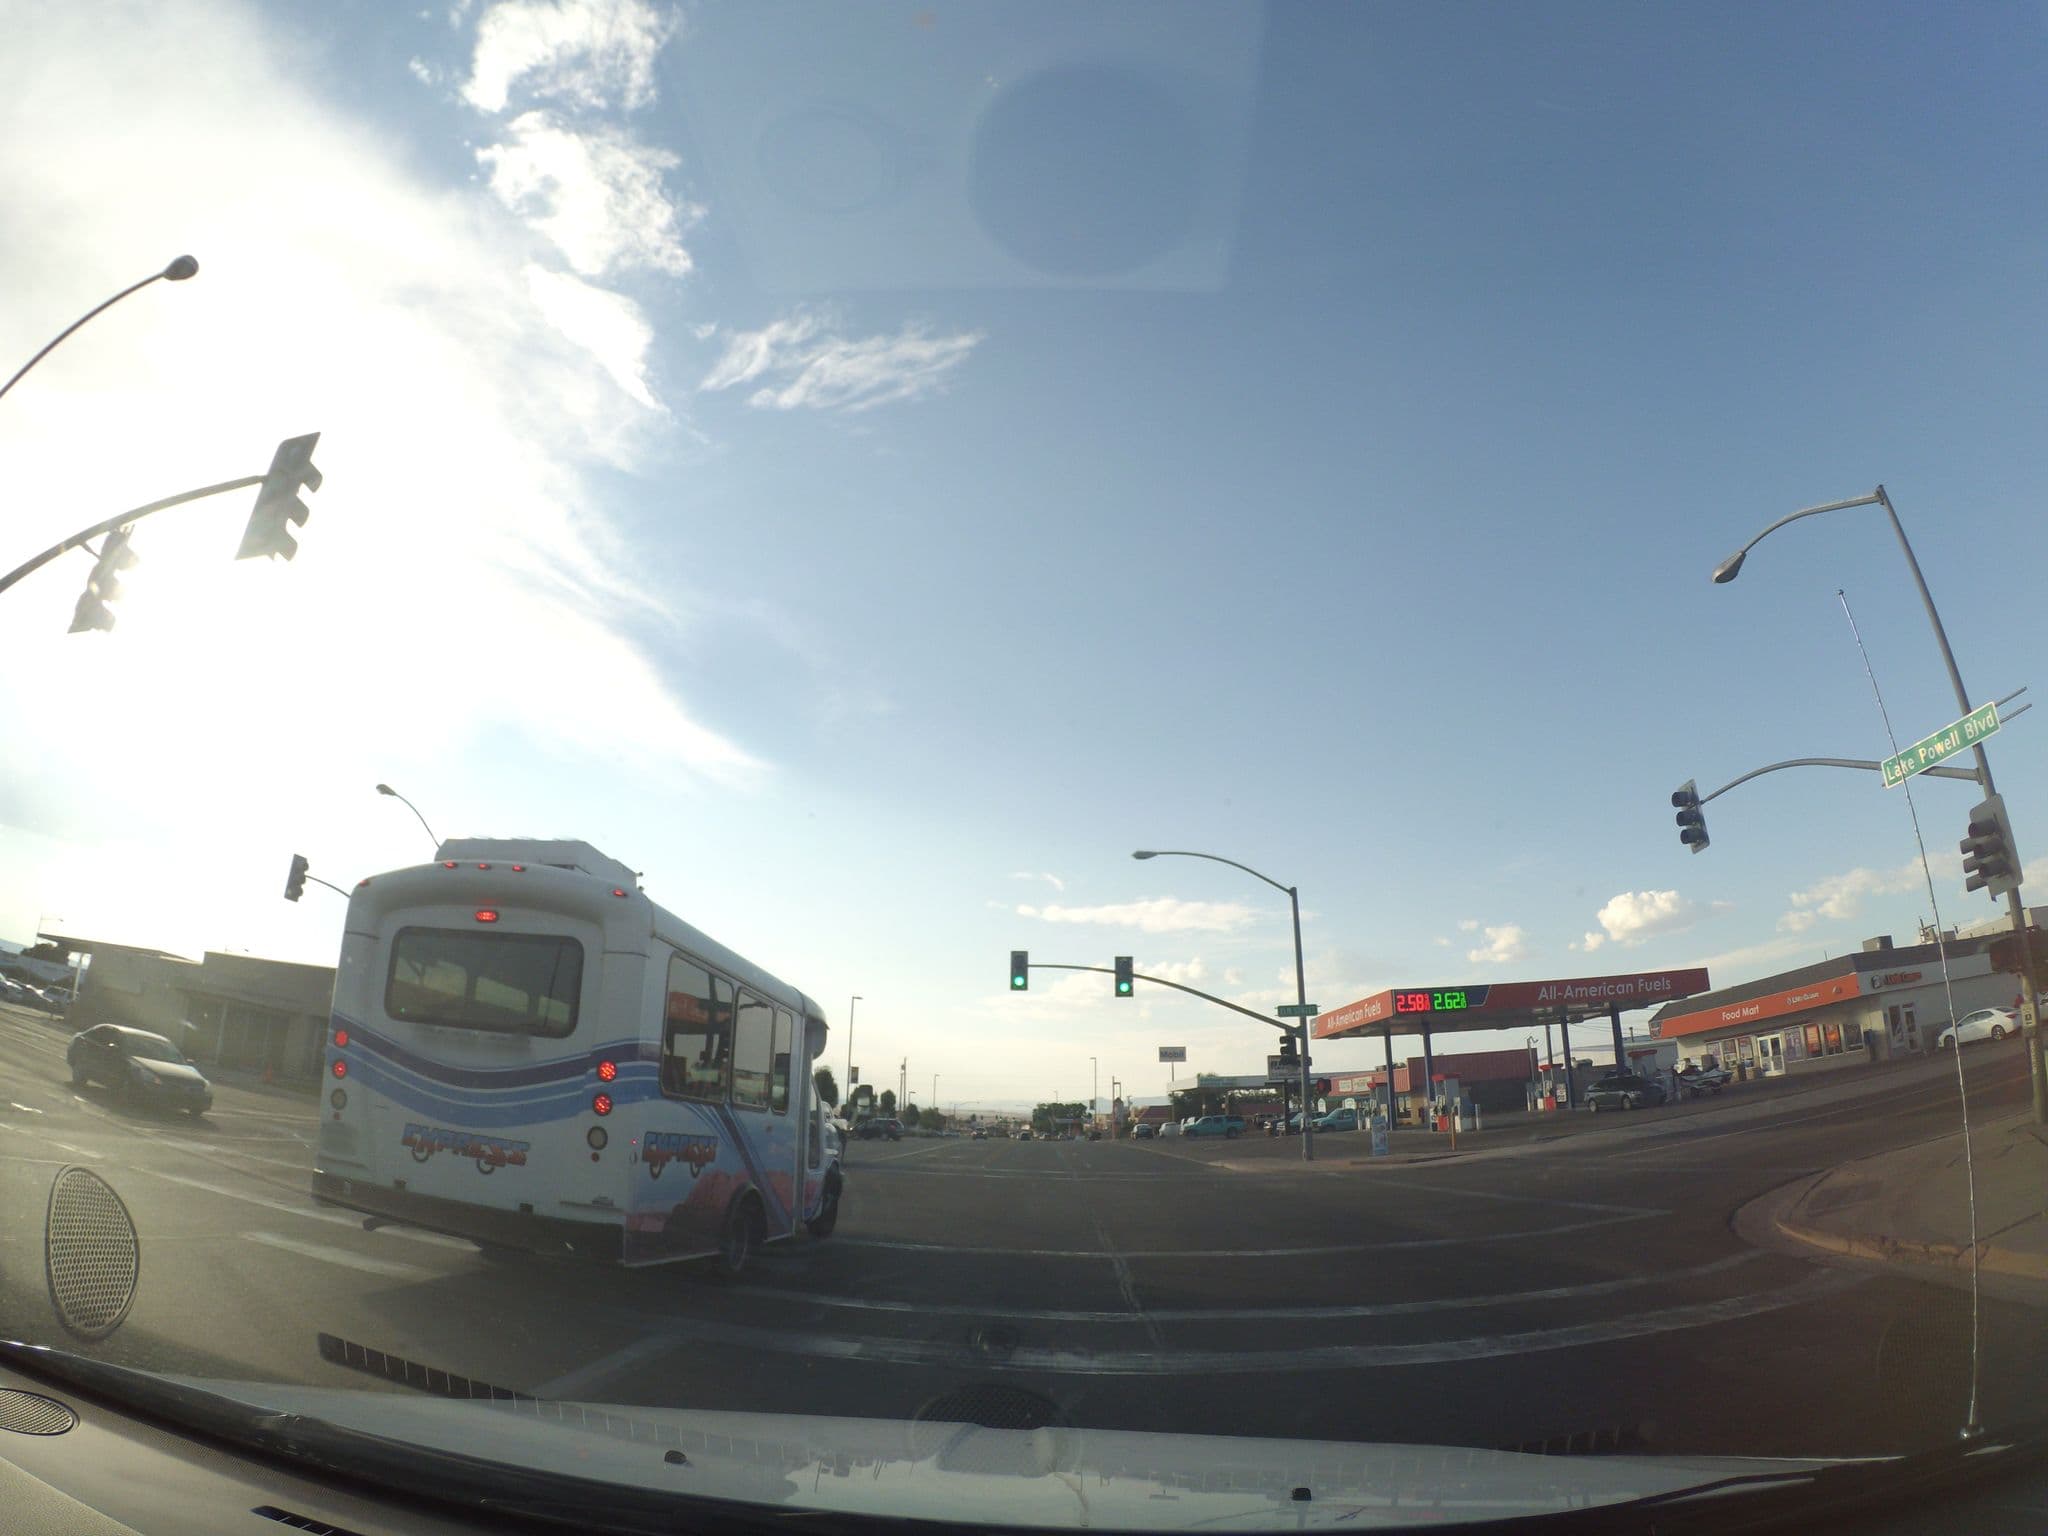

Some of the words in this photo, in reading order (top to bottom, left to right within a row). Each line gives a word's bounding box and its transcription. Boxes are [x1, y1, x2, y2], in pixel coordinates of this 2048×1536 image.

[1886, 756, 1915, 781] Lake
[1918, 730, 1960, 764] Powell
[1964, 711, 1995, 740] Blvd
[1538, 981, 1634, 1001] All-American
[1638, 977, 1671, 993] Fuels
[1327, 1007, 1364, 1028] All-American
[1721, 1007, 1741, 1021] Food
[1742, 1004, 1760, 1018] Mart
